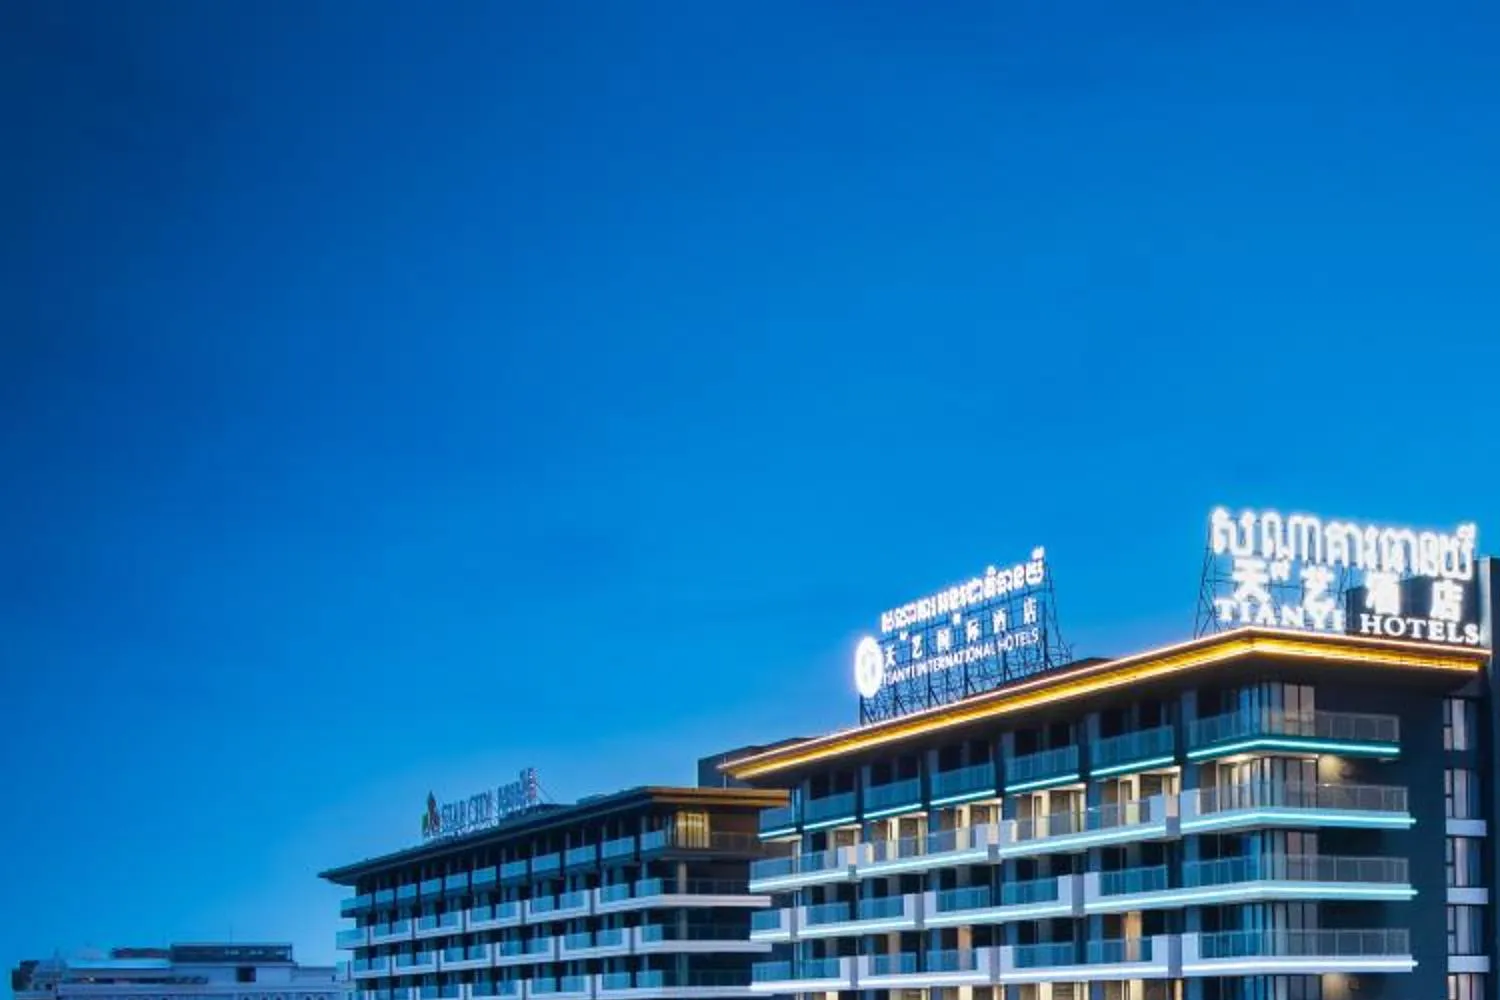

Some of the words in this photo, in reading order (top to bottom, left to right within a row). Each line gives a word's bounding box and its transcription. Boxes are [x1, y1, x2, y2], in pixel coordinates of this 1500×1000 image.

[1213, 598, 1344, 631] TIANYI
[1359, 612, 1479, 644] HOTELS
[998, 627, 1038, 651] HOTELS
